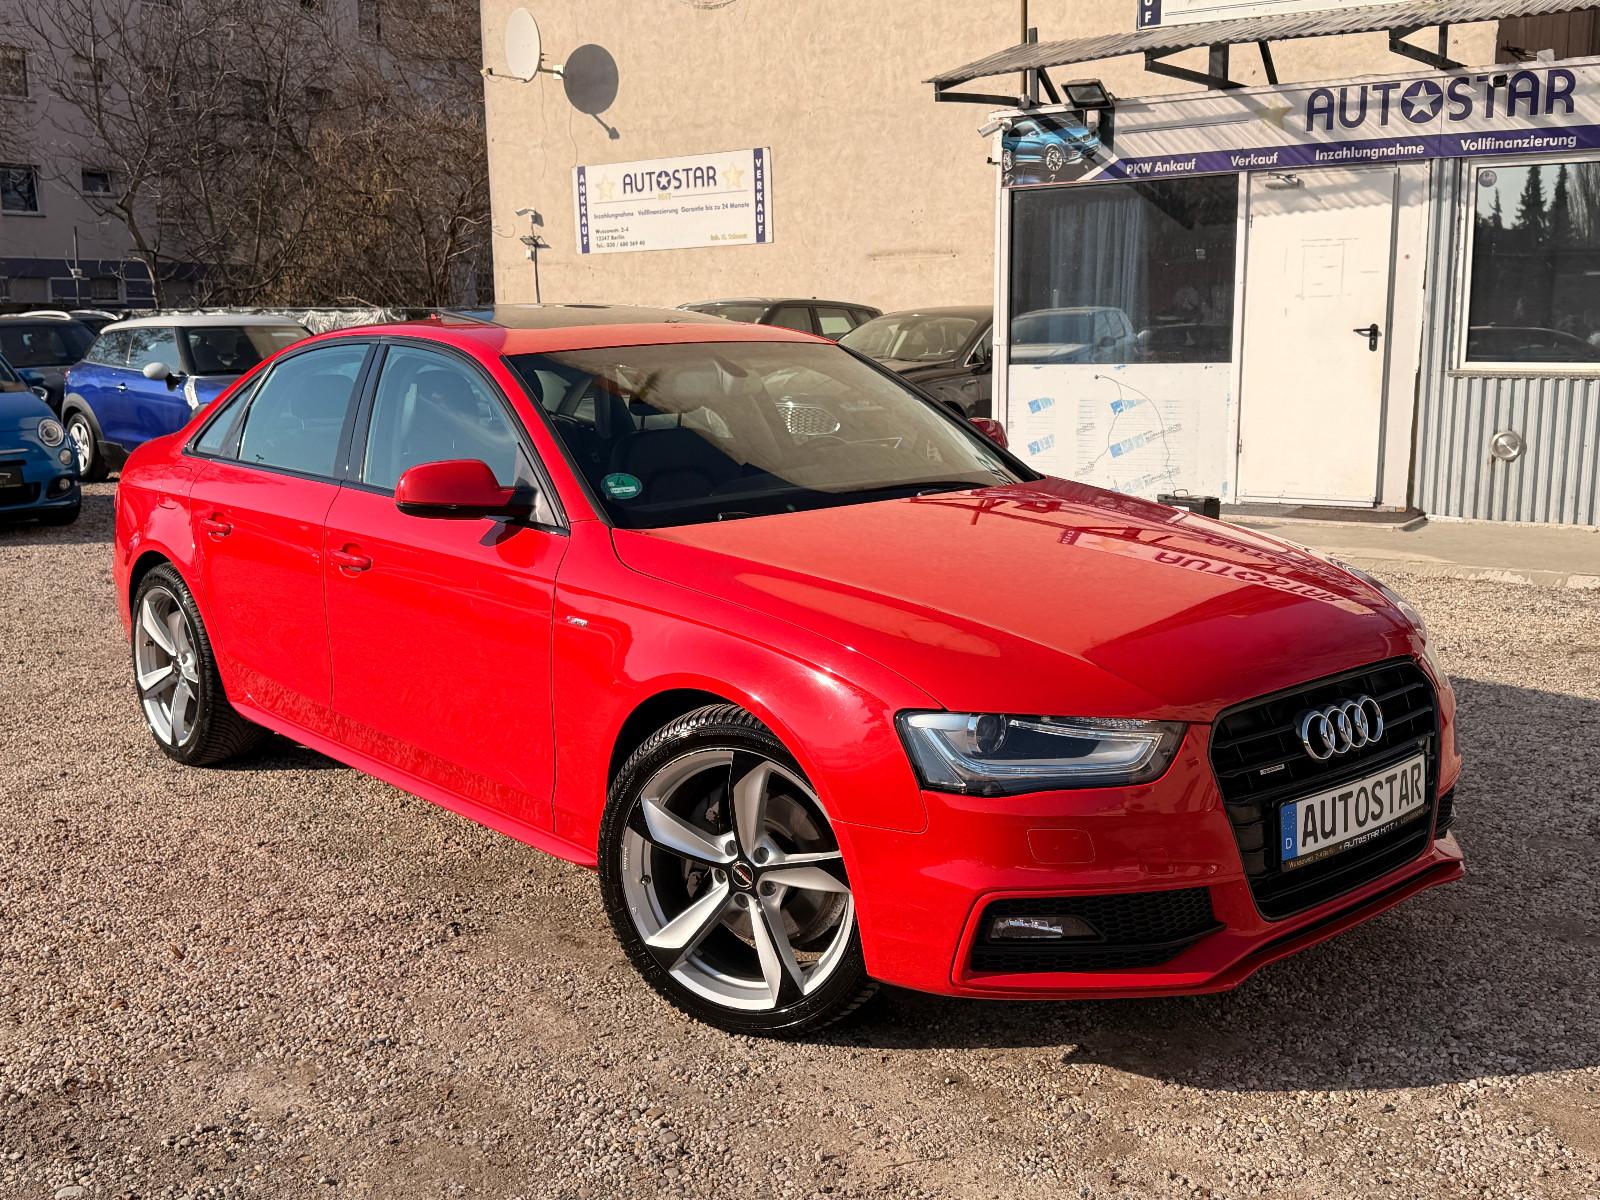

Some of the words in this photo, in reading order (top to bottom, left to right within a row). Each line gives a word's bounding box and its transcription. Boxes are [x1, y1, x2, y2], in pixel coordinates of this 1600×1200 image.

[1315, 142, 1425, 161] Inzahlungnahme
[1460, 135, 1577, 152] Vollfinanzierung
[1126, 162, 1152, 175] PKW
[1154, 158, 1196, 173] Ankauf
[1230, 151, 1279, 167] Verkauf
[622, 165, 717, 194] AUTOSTAR
[755, 158, 764, 234] VERKAUF
[1301, 762, 1423, 848] AUTOSTAR
[1285, 837, 1293, 850] D
